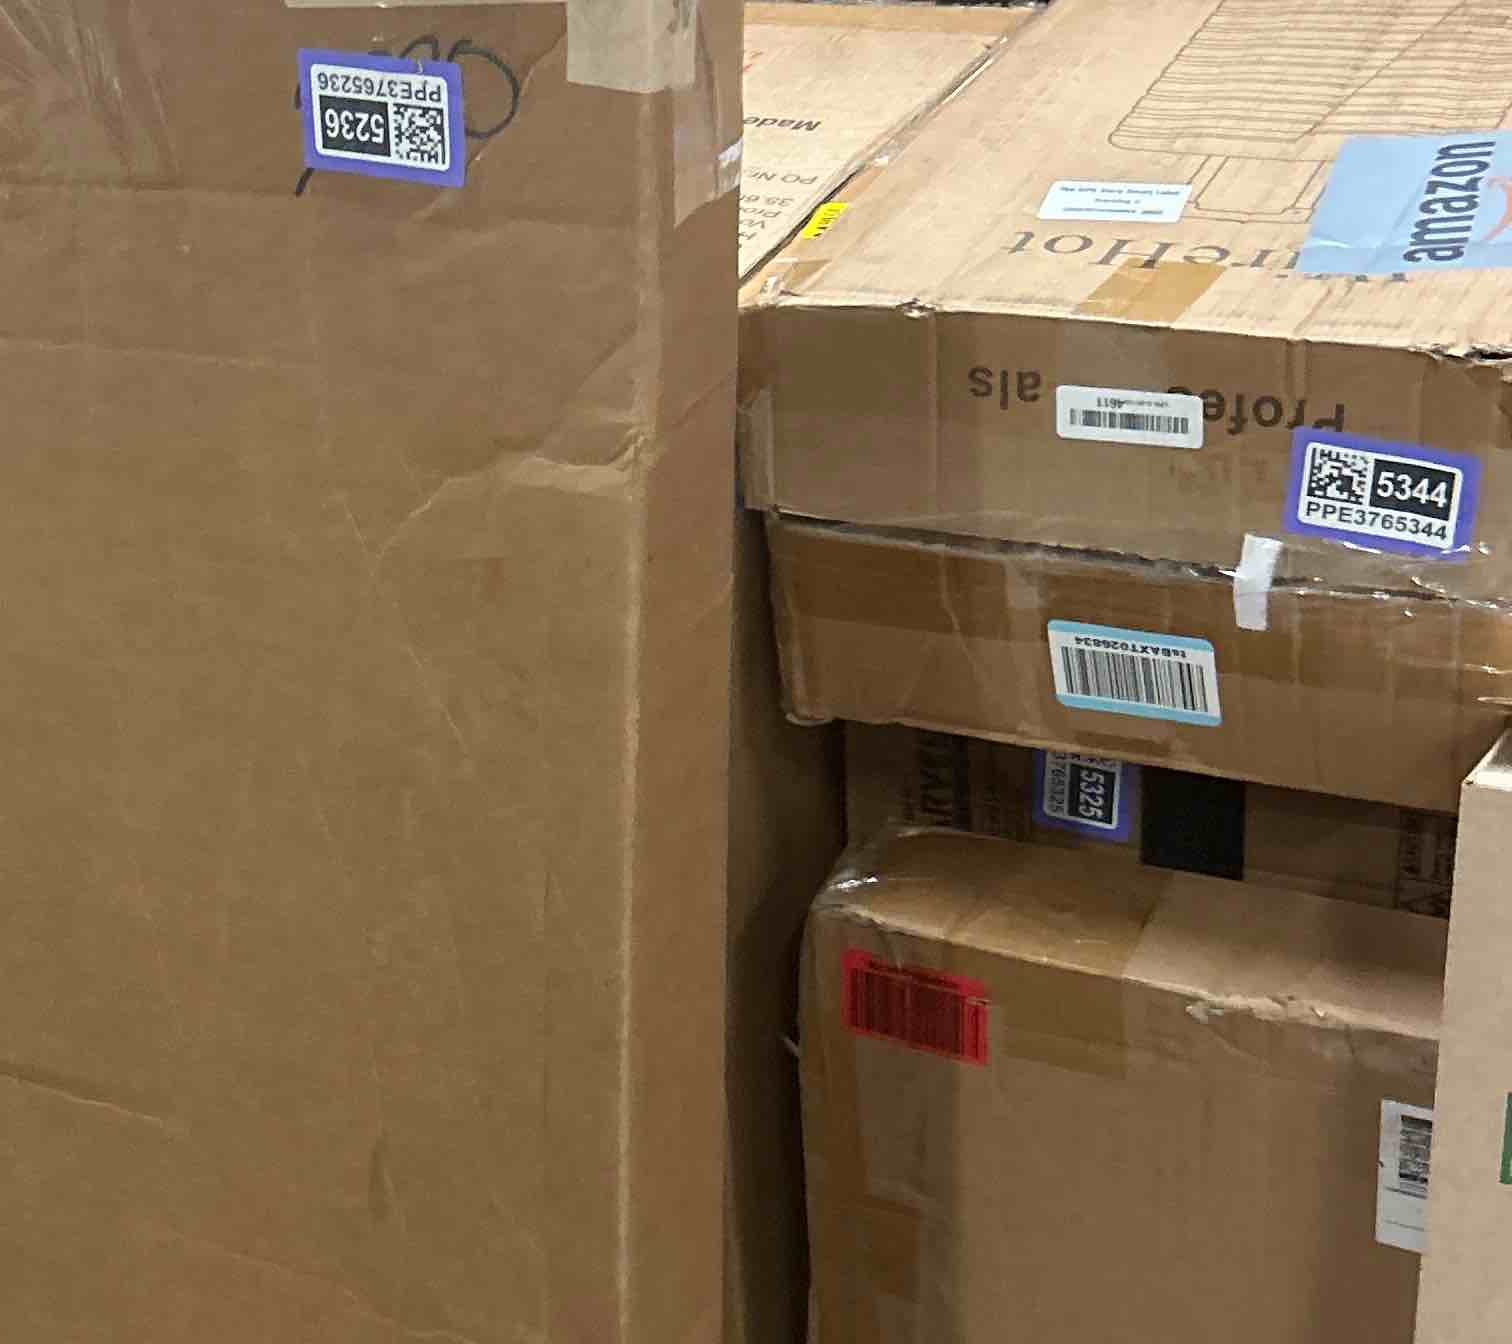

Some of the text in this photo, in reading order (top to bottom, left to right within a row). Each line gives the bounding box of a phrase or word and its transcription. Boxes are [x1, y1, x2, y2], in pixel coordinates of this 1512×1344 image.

[317, 70, 442, 103] PPE3765236
[324, 108, 386, 145] 5236
[743, 116, 822, 132] Made
[1402, 140, 1497, 263] amazon
[1376, 471, 1448, 508] 5344
[1305, 500, 1448, 541] PPE3765344
[1078, 769, 1106, 819] 5325
